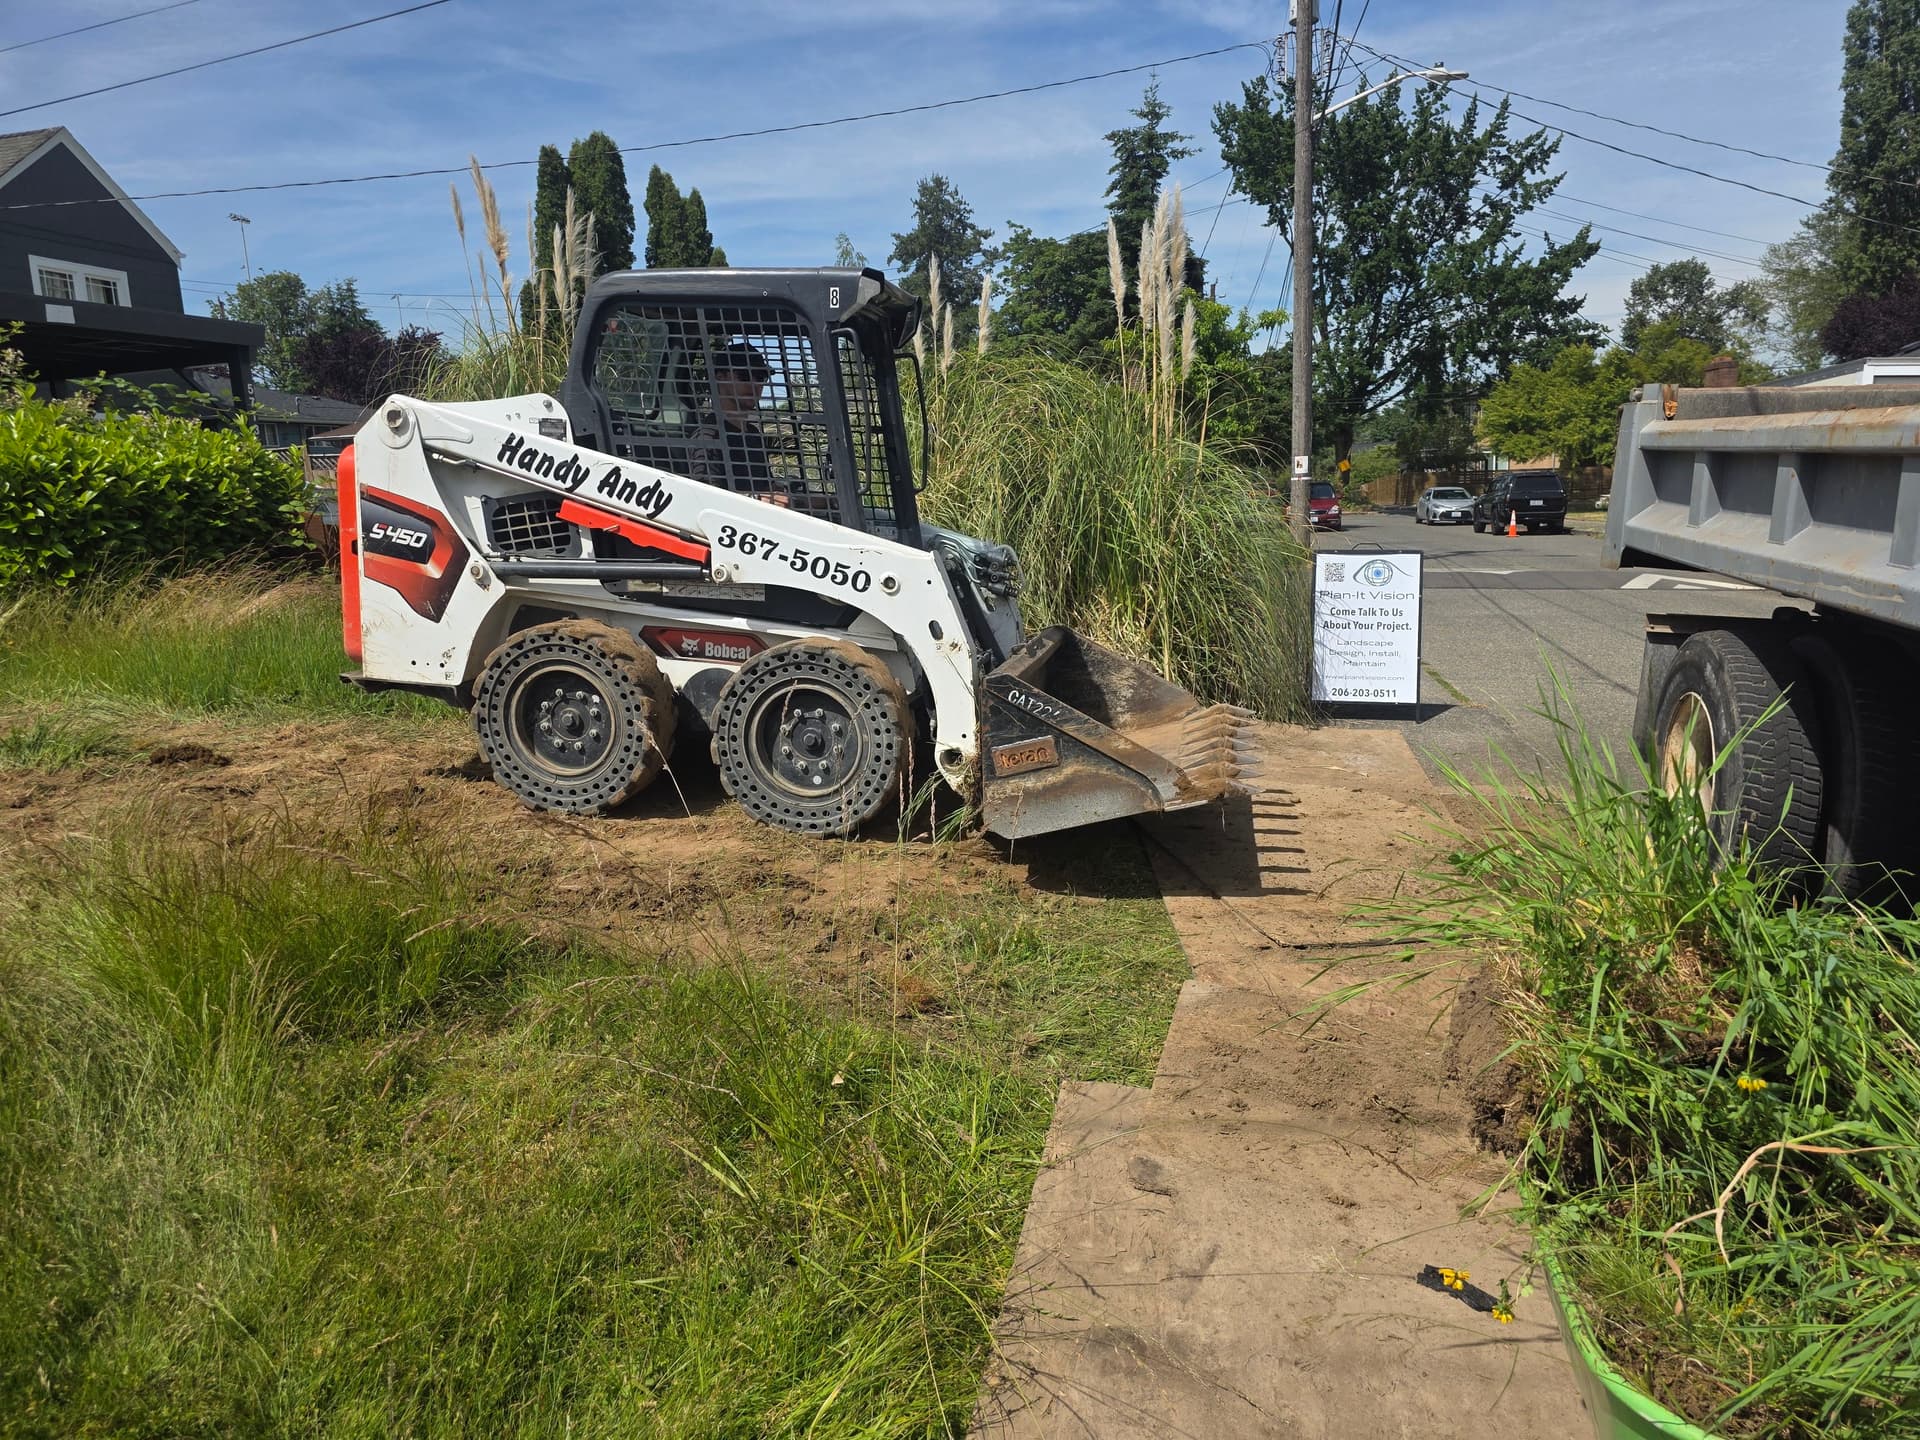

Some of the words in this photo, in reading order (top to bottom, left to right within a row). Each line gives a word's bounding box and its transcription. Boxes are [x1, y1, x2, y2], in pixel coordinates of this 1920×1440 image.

[831, 289, 838, 306] 8
[497, 432, 590, 493] Handy
[597, 466, 673, 519] Andy
[369, 523, 428, 548] S450
[717, 525, 872, 593] 367-5050
[1319, 590, 1366, 600] Plan-It
[1369, 591, 1415, 600] Vision
[1330, 607, 1356, 617] Come
[1358, 608, 1377, 617] Talk
[1379, 608, 1390, 617] To
[1391, 608, 1404, 617] Us
[1323, 620, 1352, 630] About
[1353, 621, 1374, 630] Your
[1376, 621, 1413, 633] Project.
[704, 641, 752, 660] Bobcat
[1337, 640, 1394, 648] Landscape
[1329, 648, 1367, 658] Design,
[1369, 650, 1401, 658] Install,
[1343, 660, 1387, 668] Maintain
